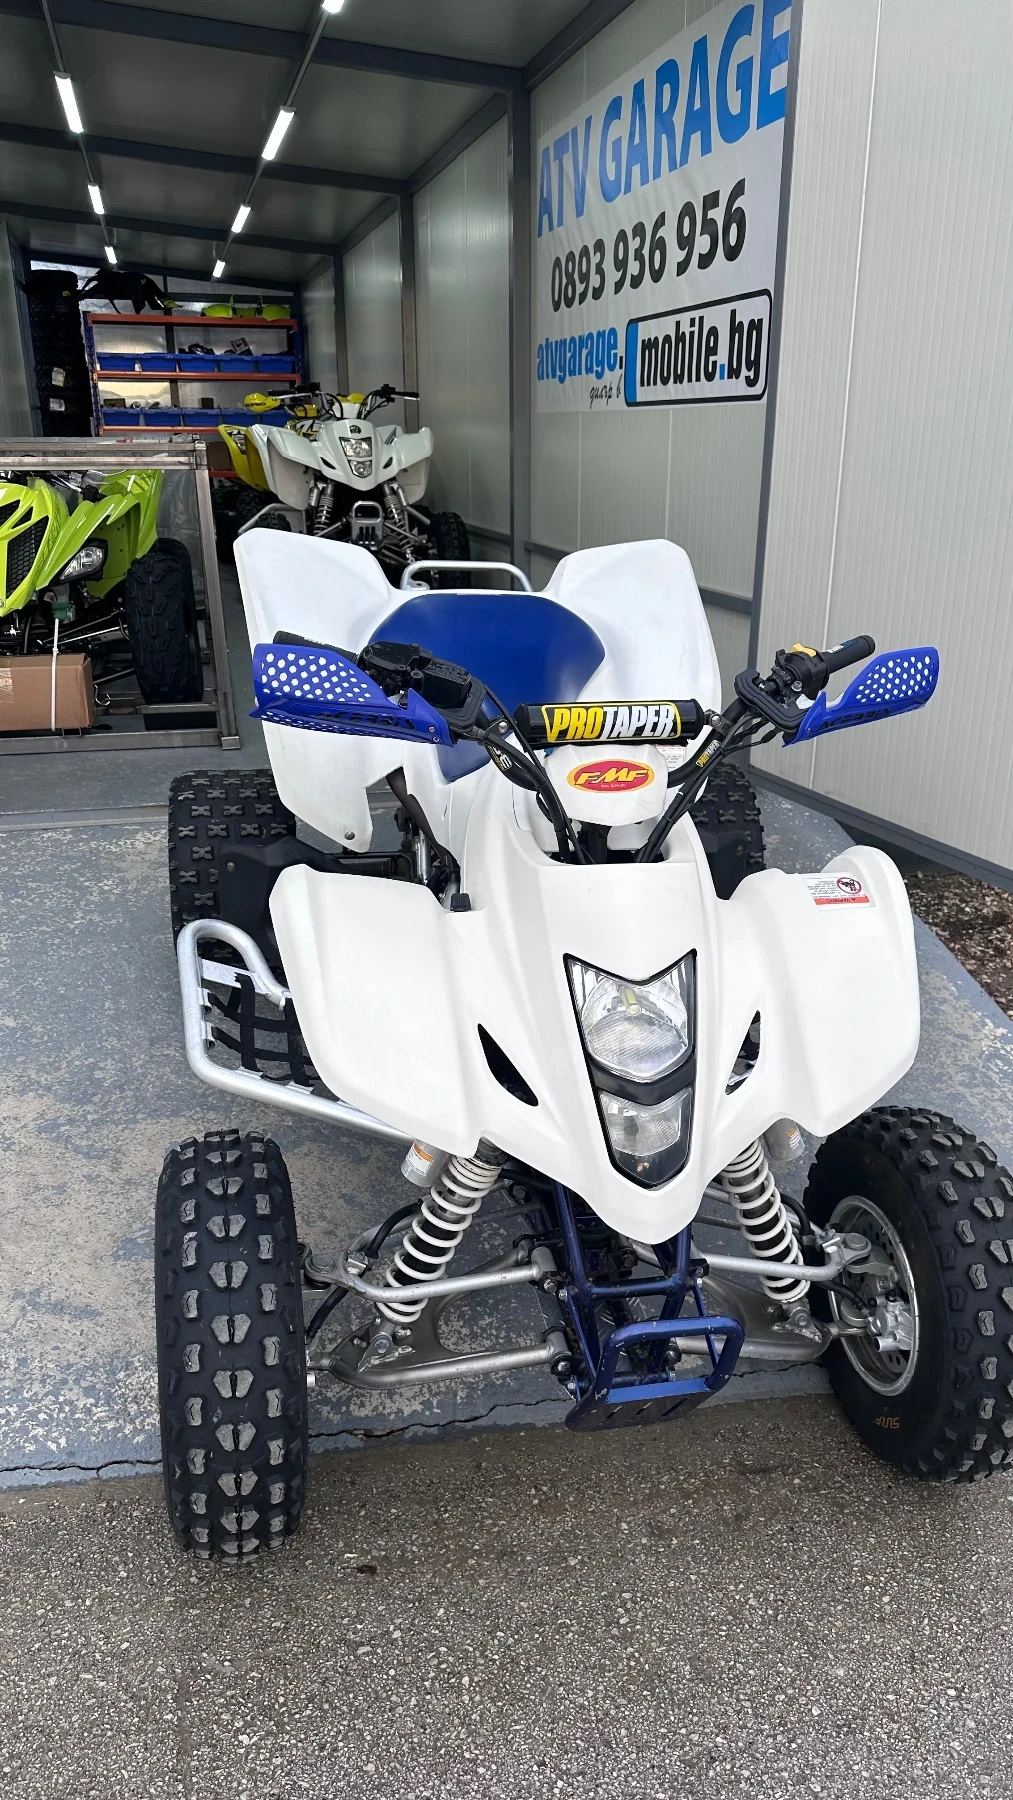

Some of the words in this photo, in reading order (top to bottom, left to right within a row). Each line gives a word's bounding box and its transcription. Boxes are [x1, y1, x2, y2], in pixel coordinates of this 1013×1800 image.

[537, 115, 592, 237] ATV
[599, 0, 792, 204] GARAGE
[551, 238, 606, 313] 0893
[613, 211, 666, 295] 936
[676, 178, 746, 277] 956
[640, 309, 763, 388] mobile.bg
[574, 767, 649, 785] FMF
